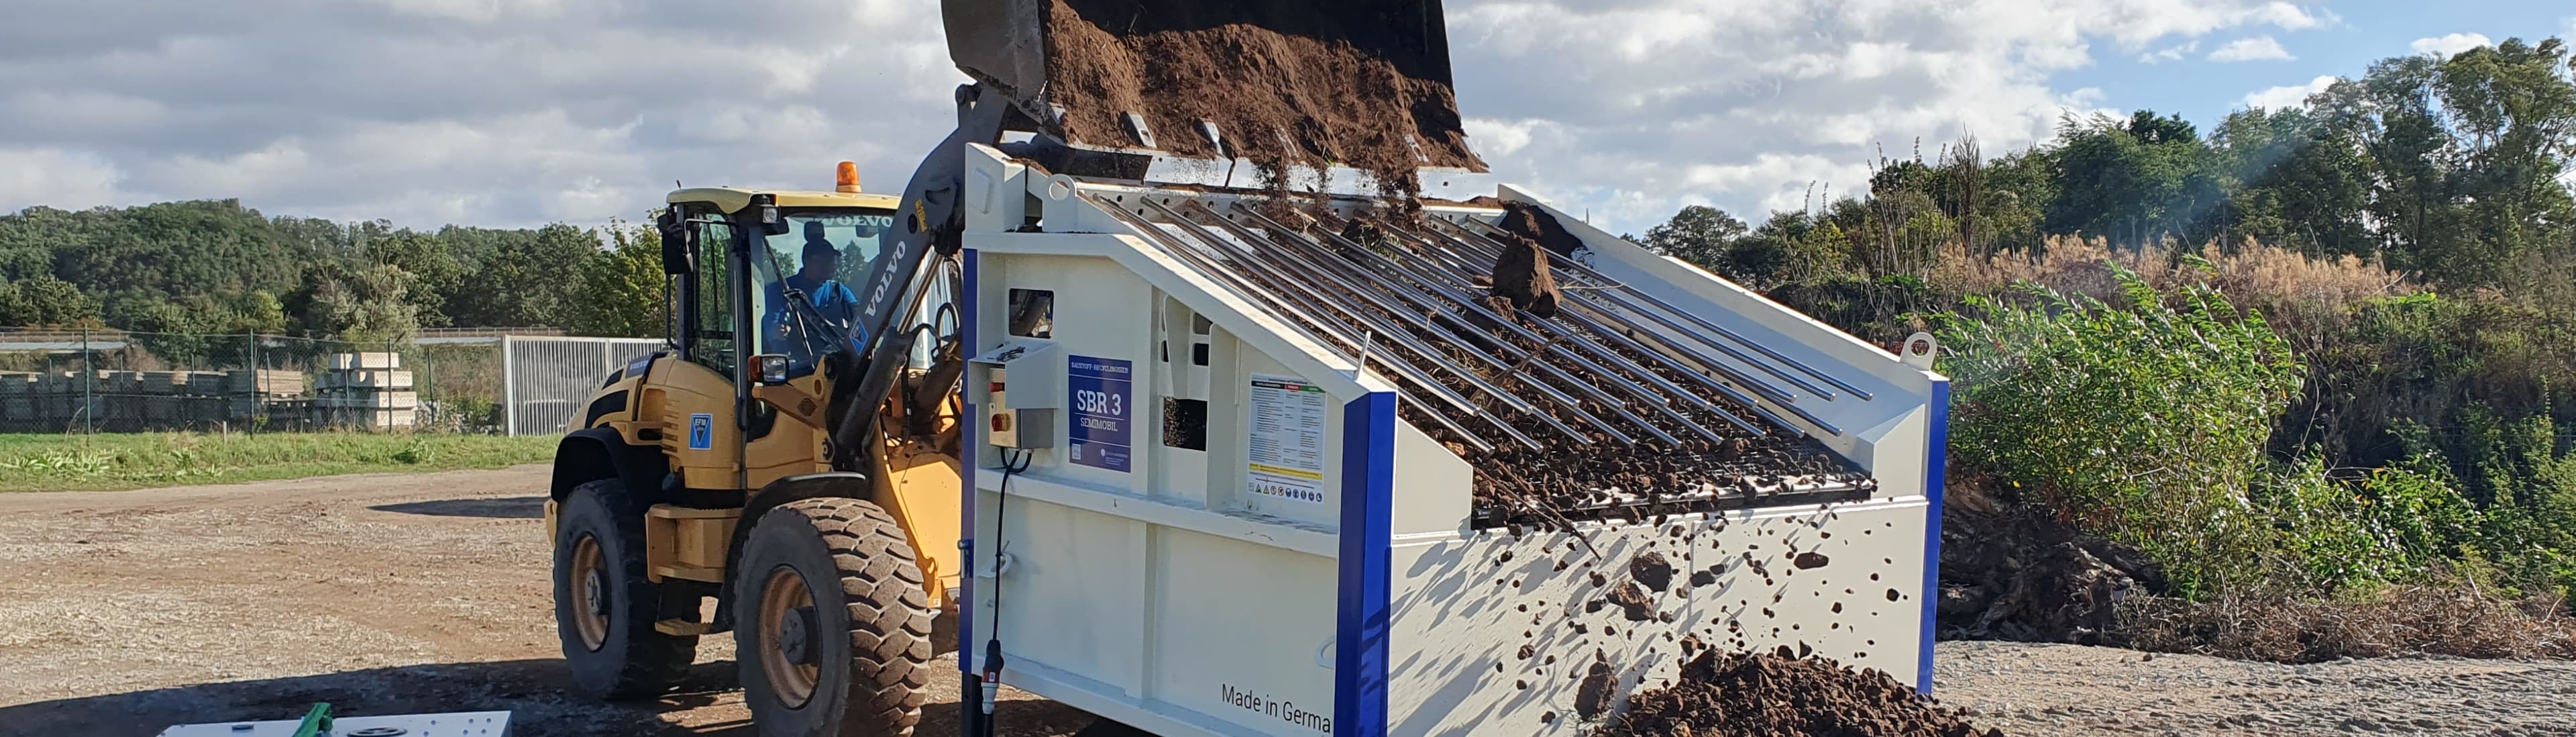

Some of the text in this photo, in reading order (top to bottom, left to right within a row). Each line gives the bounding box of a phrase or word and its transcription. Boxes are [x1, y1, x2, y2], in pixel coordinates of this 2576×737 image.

[865, 241, 906, 317] VOLVO
[1077, 389, 1121, 415] SBR 3
[1080, 417, 1118, 432] SEMIMOBIL
[1222, 683, 1330, 734] Made in Germa
